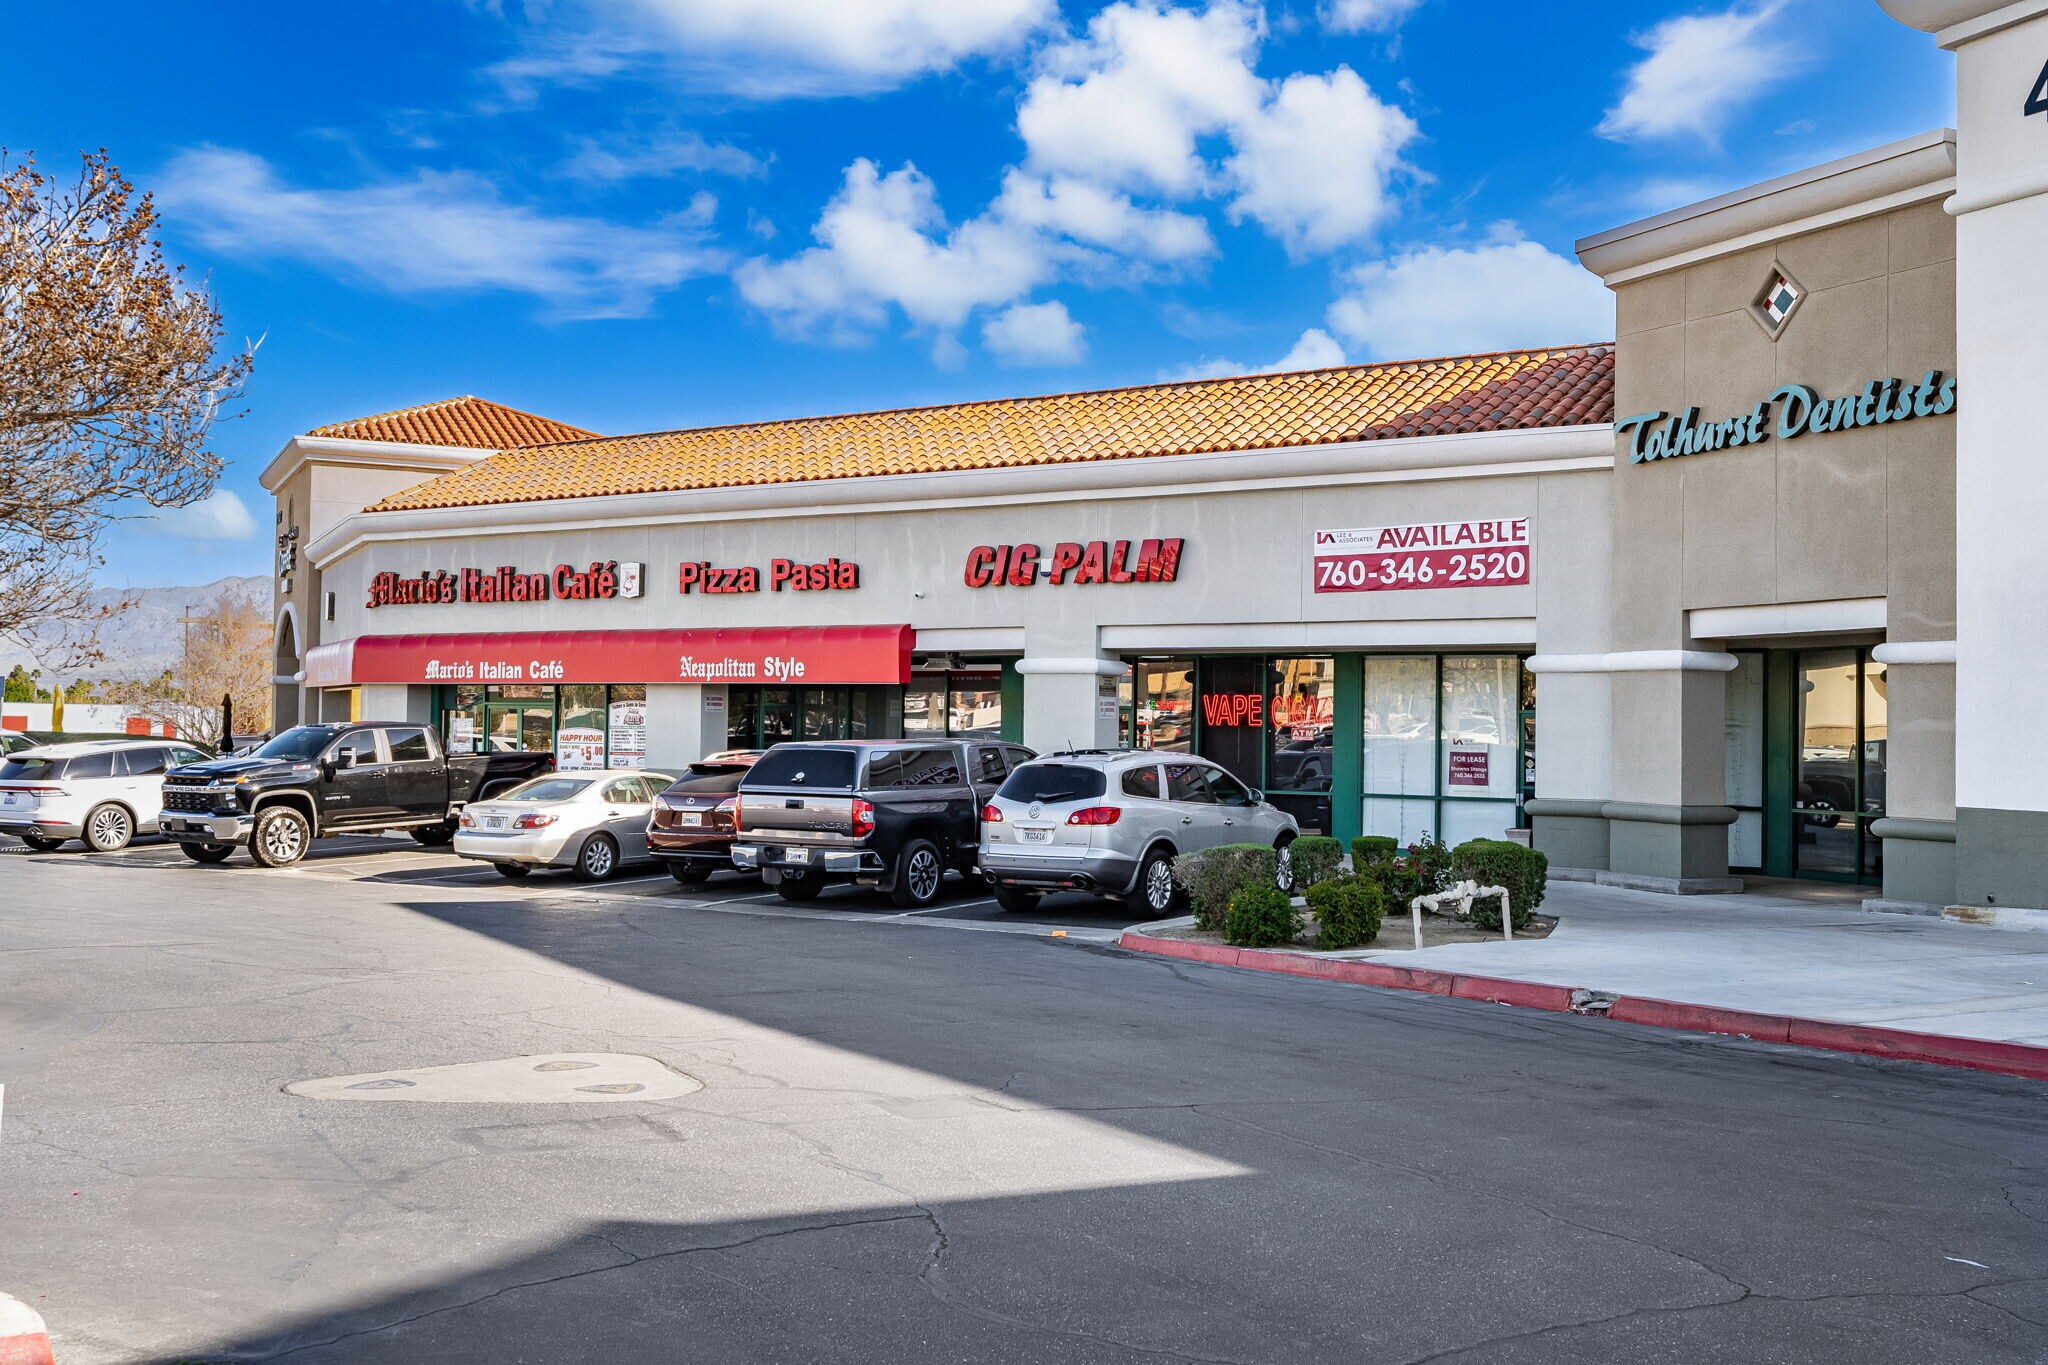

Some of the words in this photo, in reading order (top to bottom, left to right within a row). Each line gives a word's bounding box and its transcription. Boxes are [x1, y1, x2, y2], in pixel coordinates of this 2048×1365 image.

[1614, 405, 1770, 464] Tolhurst
[1767, 370, 1956, 439] Dentists
[1376, 519, 1527, 549] AVAILABLE
[680, 561, 760, 594] Pizza
[771, 557, 860, 592] Pasta
[1318, 551, 1526, 587] 760-346-2520
[365, 569, 457, 608] Mario's
[459, 565, 549, 602] Italian
[551, 560, 618, 599] Café
[425, 659, 474, 680] Mario's
[479, 661, 522, 679] Italian
[529, 660, 564, 679] Café
[679, 655, 756, 682] Neapolitan
[763, 656, 805, 682] Style
[1203, 694, 1263, 726] VAPE
[560, 734, 583, 742] HAPPY
[1292, 729, 1314, 737] ATM
[1453, 755, 1466, 763] FOR
[807, 820, 850, 830] TUNDRA
